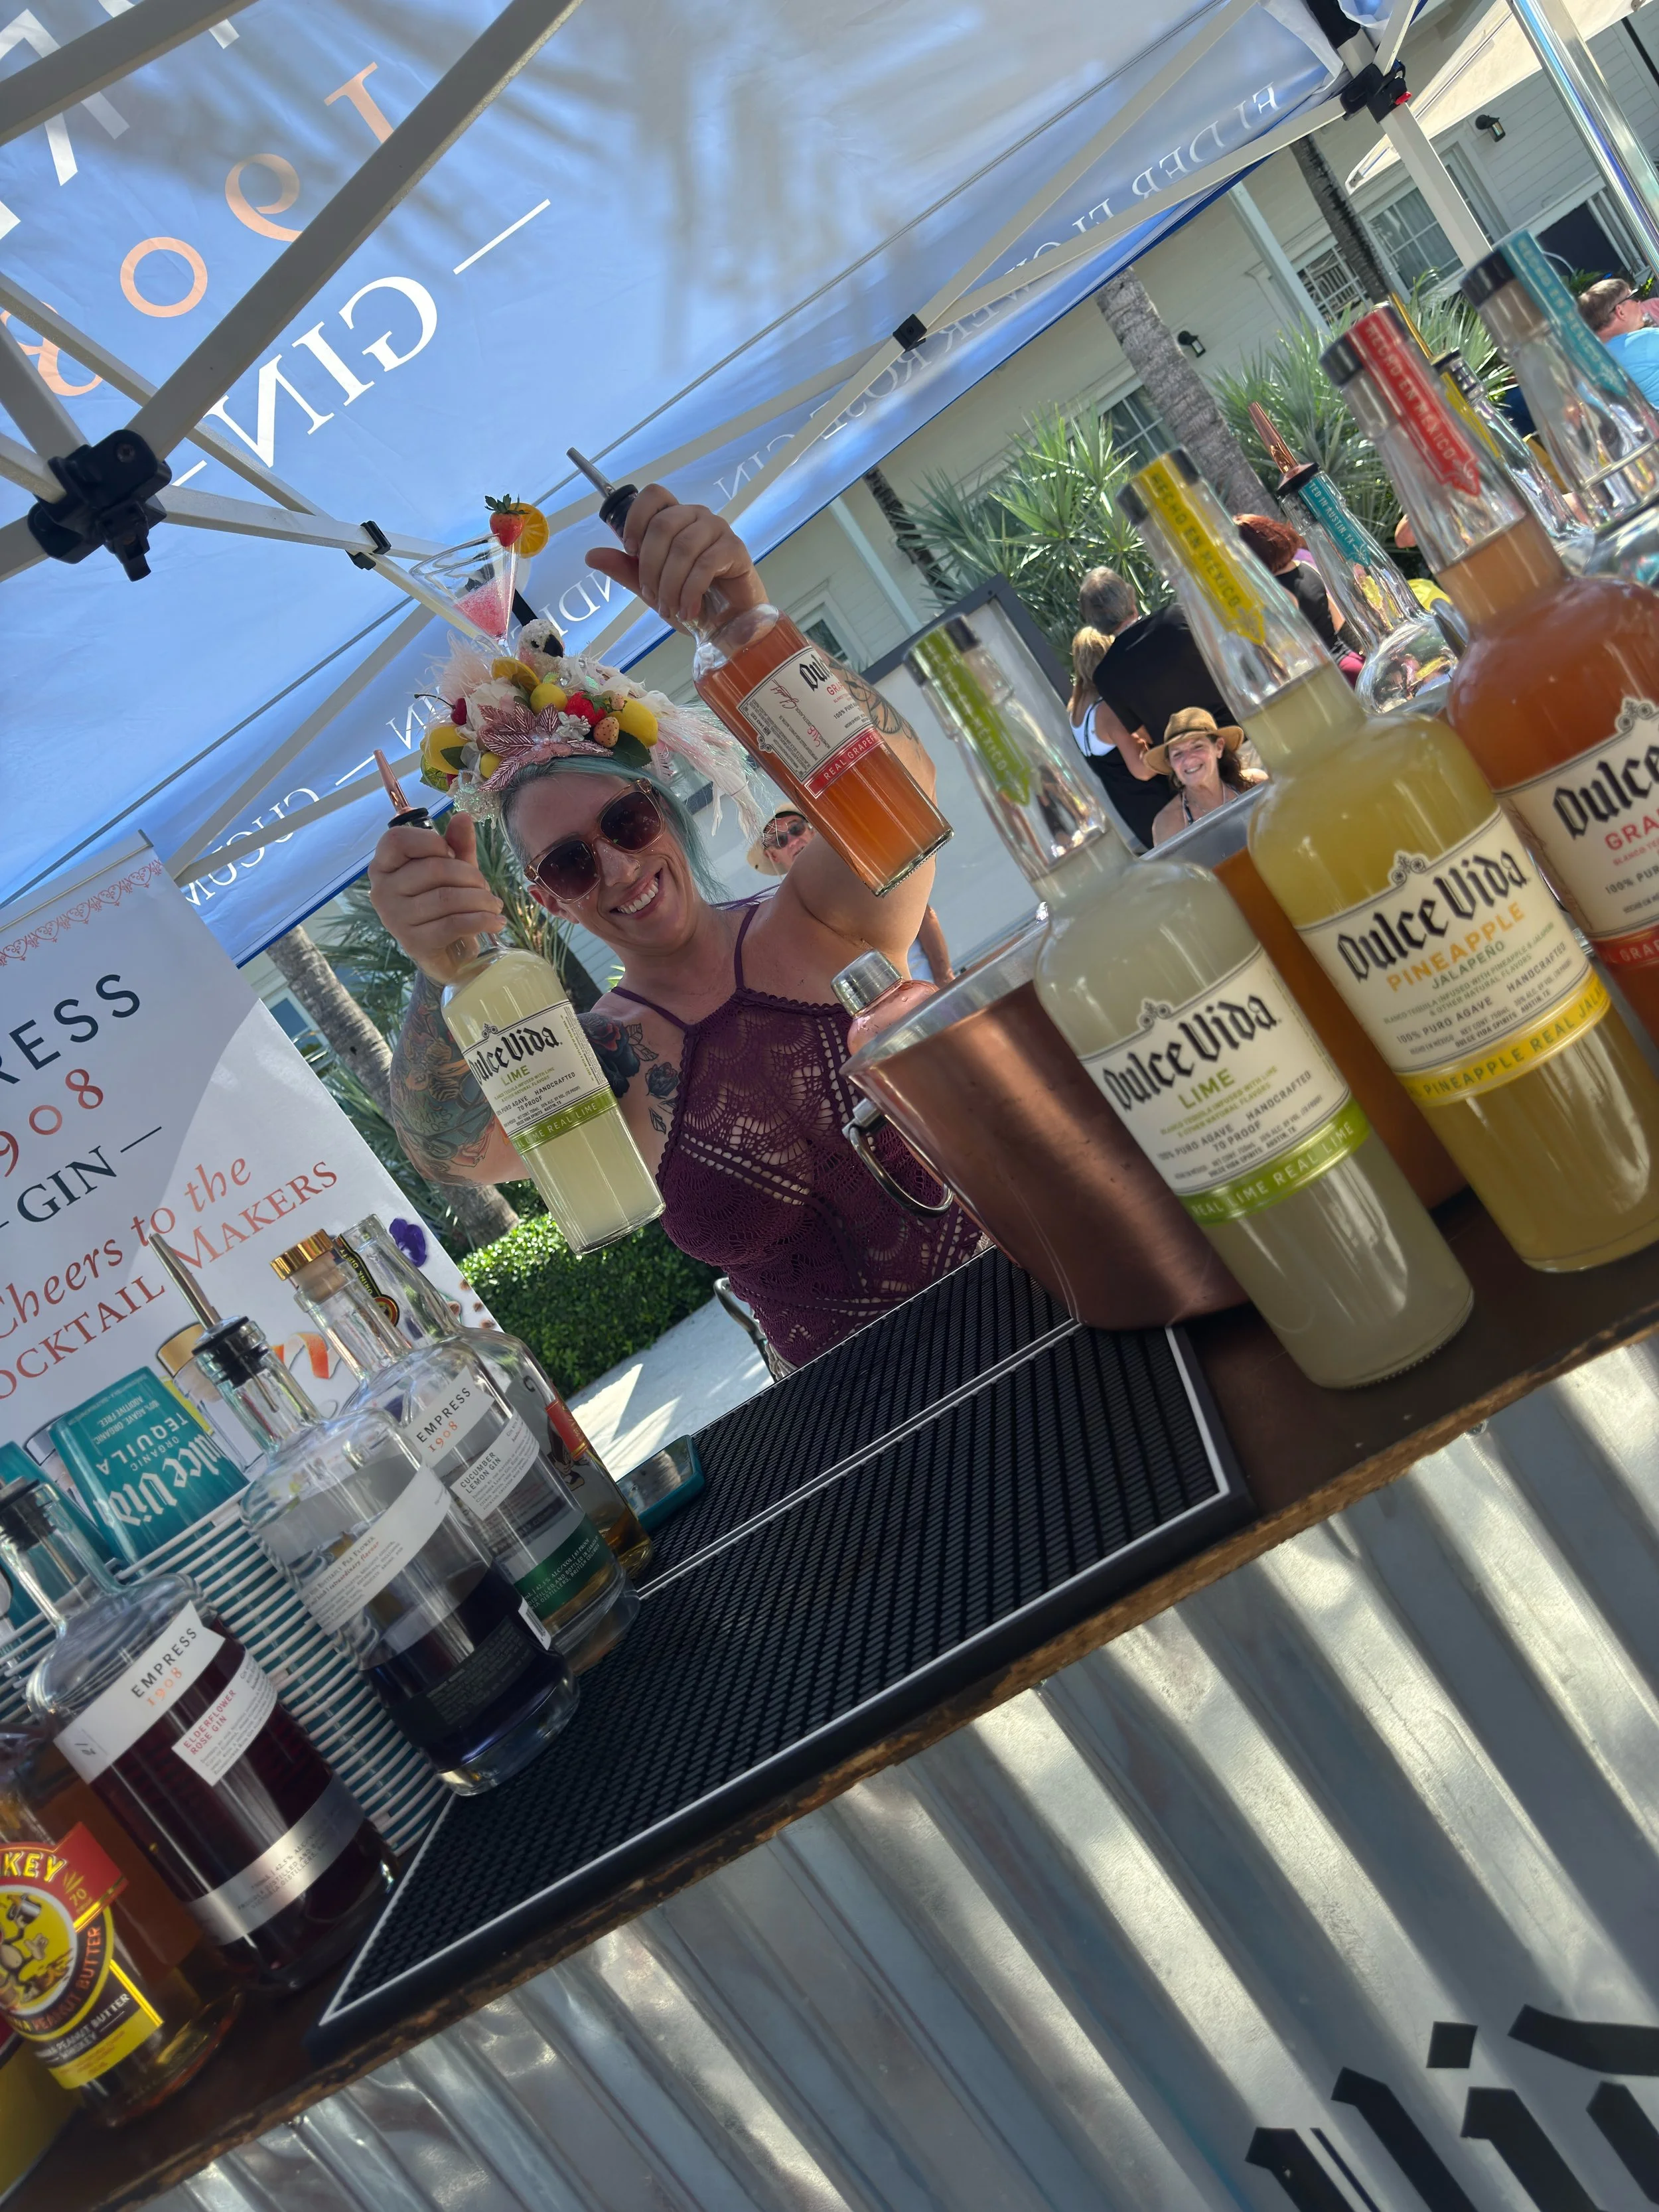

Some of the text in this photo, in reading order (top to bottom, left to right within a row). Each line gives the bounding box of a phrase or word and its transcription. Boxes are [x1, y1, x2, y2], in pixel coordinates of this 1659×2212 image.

[1344, 534, 1354, 545] TX
[823, 758, 847, 780] REAL
[1337, 850, 1526, 981] Dulce Vida
[1386, 900, 1527, 995] PINEAPPLE
[1427, 938, 1507, 990] JALAPEÑO
[1396, 942, 1567, 1047] 100% PURO AGAVE HANDCRAFTED
[469, 1045, 508, 1085] Dulce
[501, 1027, 560, 1062] Vida
[500, 1064, 530, 1086] LIME
[1103, 995, 1278, 1111] Dulce Vida
[1423, 1047, 1526, 1096] PINEAPPLE
[1529, 1015, 1575, 1053] REAL
[511, 1095, 528, 1108] AGAVE
[534, 1071, 576, 1096] HANDCRAFTED
[524, 1094, 543, 1108] PROOF
[1177, 1067, 1236, 1112] LIME
[547, 1102, 597, 1132] REAL LIME
[1174, 1070, 1313, 1159] PURO AGAVE HANDCRAFTED
[1212, 1119, 1263, 1153] 70 PROOF
[17, 1146, 117, 1223] GIN
[1190, 1121, 1354, 1218] REAL LIME REAL LIME
[131, 1207, 176, 1246] to
[184, 1153, 252, 1213] the
[170, 1161, 338, 1270] MAKERS
[340, 1248, 373, 1293] DRINK DIRTY
[415, 1386, 472, 1443] EMPRESS
[95, 1410, 188, 1477] TEQUILA
[129, 1435, 179, 1472] ORGANIC
[427, 1420, 459, 1455] 1908
[459, 1451, 496, 1489] CUCUMBER
[465, 1456, 502, 1494] LEMON GIN
[94, 1473, 178, 1528] Vida
[554, 1573, 566, 1585] AND
[565, 1555, 583, 1575] BOTTLED
[569, 1559, 587, 1578] BRITISH
[130, 1625, 198, 1699] EMPRESS
[145, 1665, 184, 1709] 1908
[182, 1688, 237, 1749] ELDERFLOWER
[189, 1714, 228, 1755] ROSE GIN
[70, 1887, 88, 1907] 70
[74, 1925, 102, 1990] BUTTER
[90, 1992, 130, 2028] BUTTER
